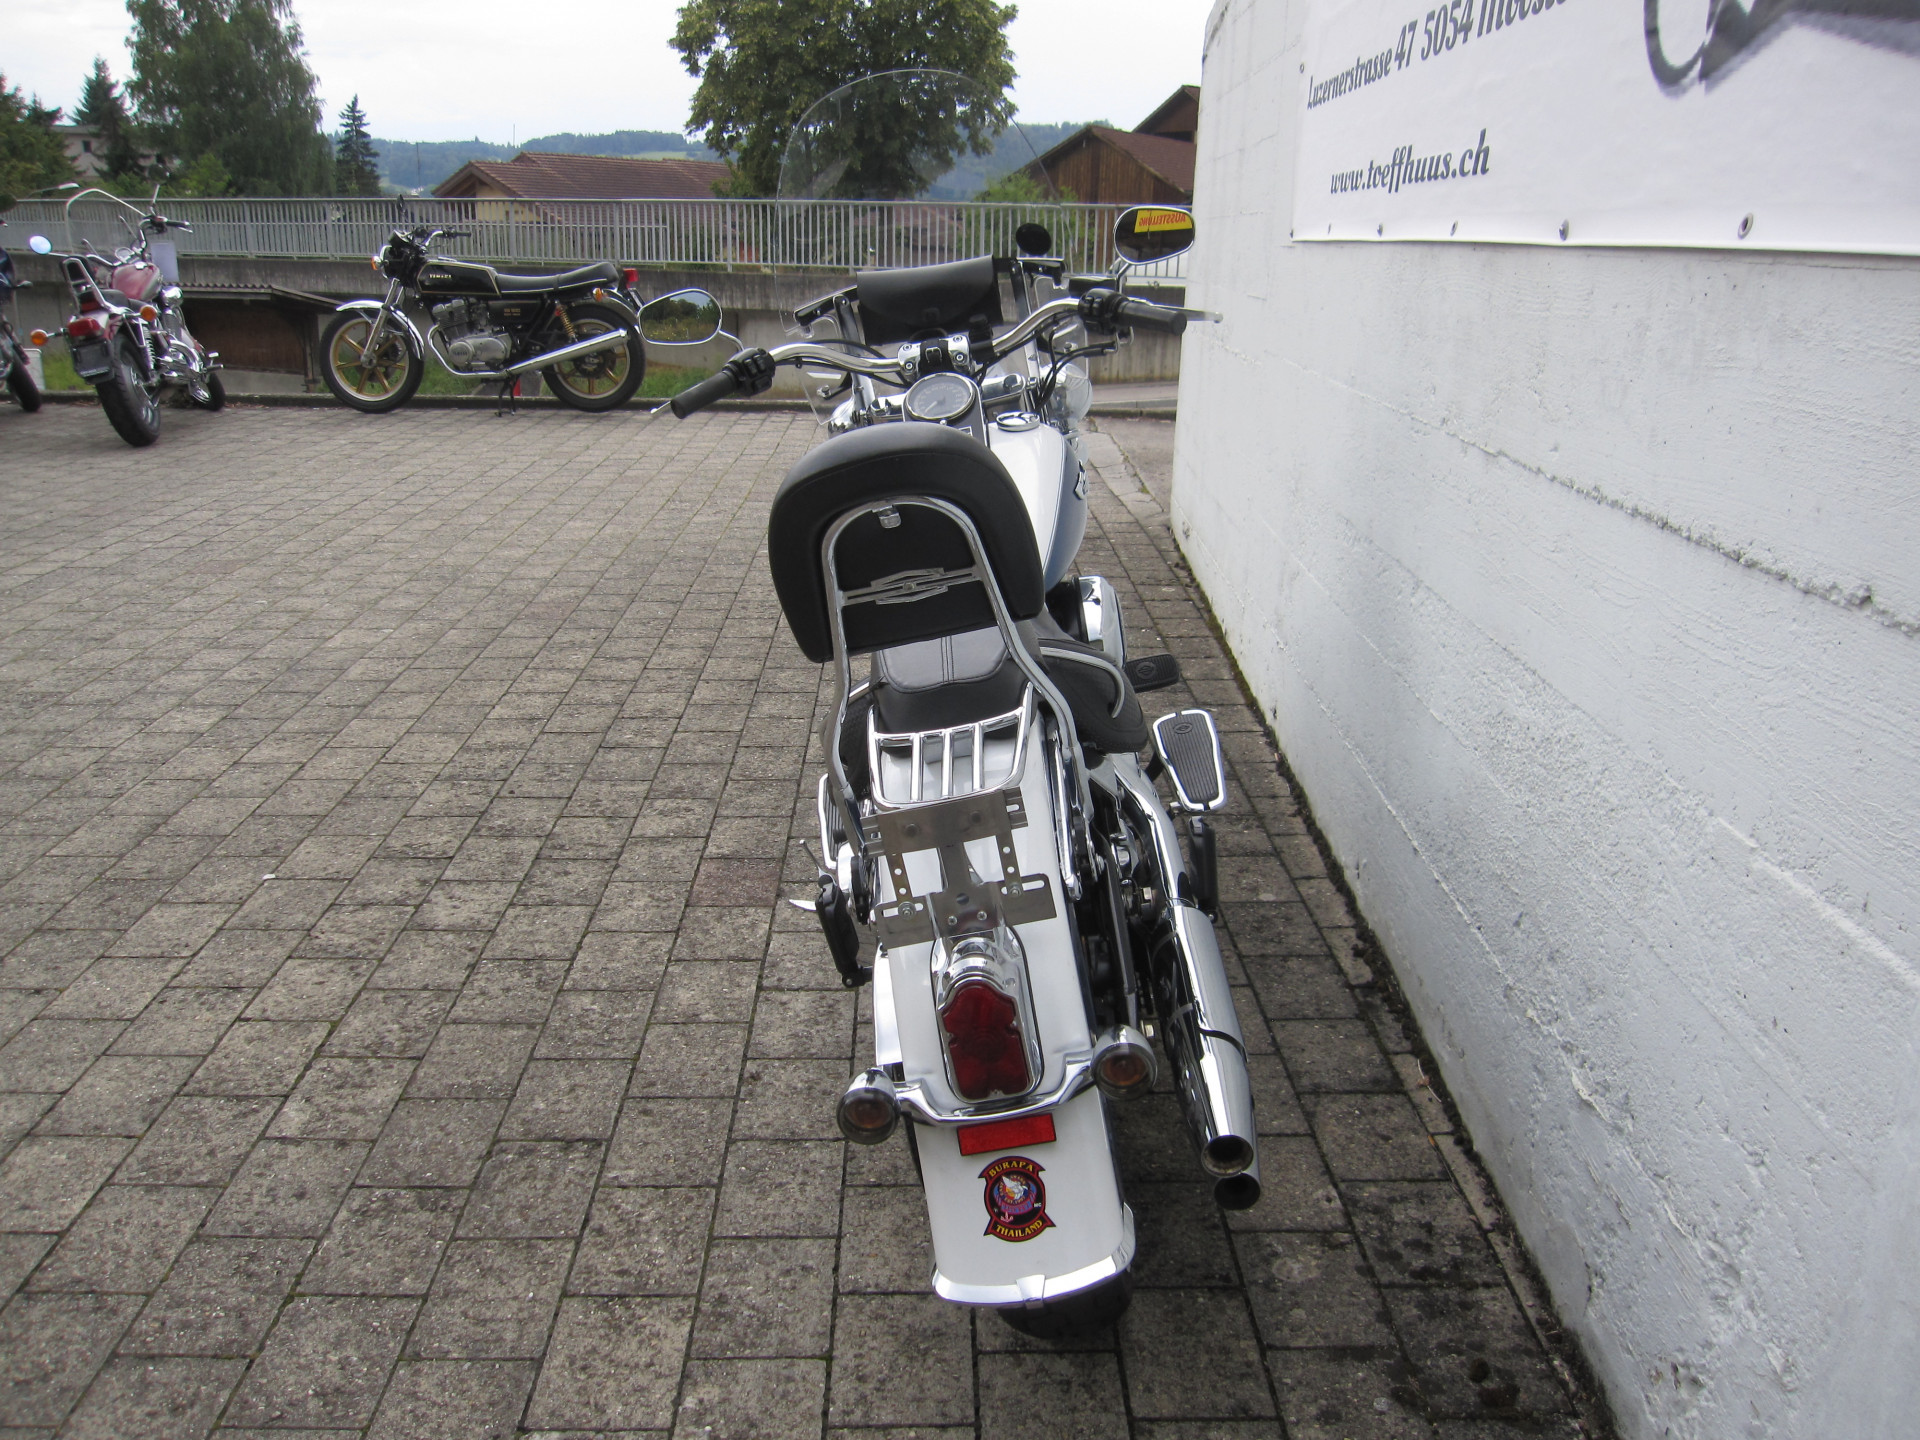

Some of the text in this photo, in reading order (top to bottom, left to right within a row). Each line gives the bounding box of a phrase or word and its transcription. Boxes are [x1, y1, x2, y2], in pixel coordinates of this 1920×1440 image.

[1307, 48, 1393, 110] Luzernerstrasse
[1394, 19, 1418, 71] 47
[1421, 0, 1474, 61] 5054
[1330, 128, 1490, 194] www.toeffhuus.ch
[989, 1161, 1033, 1176] BURAPA
[996, 1220, 1042, 1237] THAILAND
